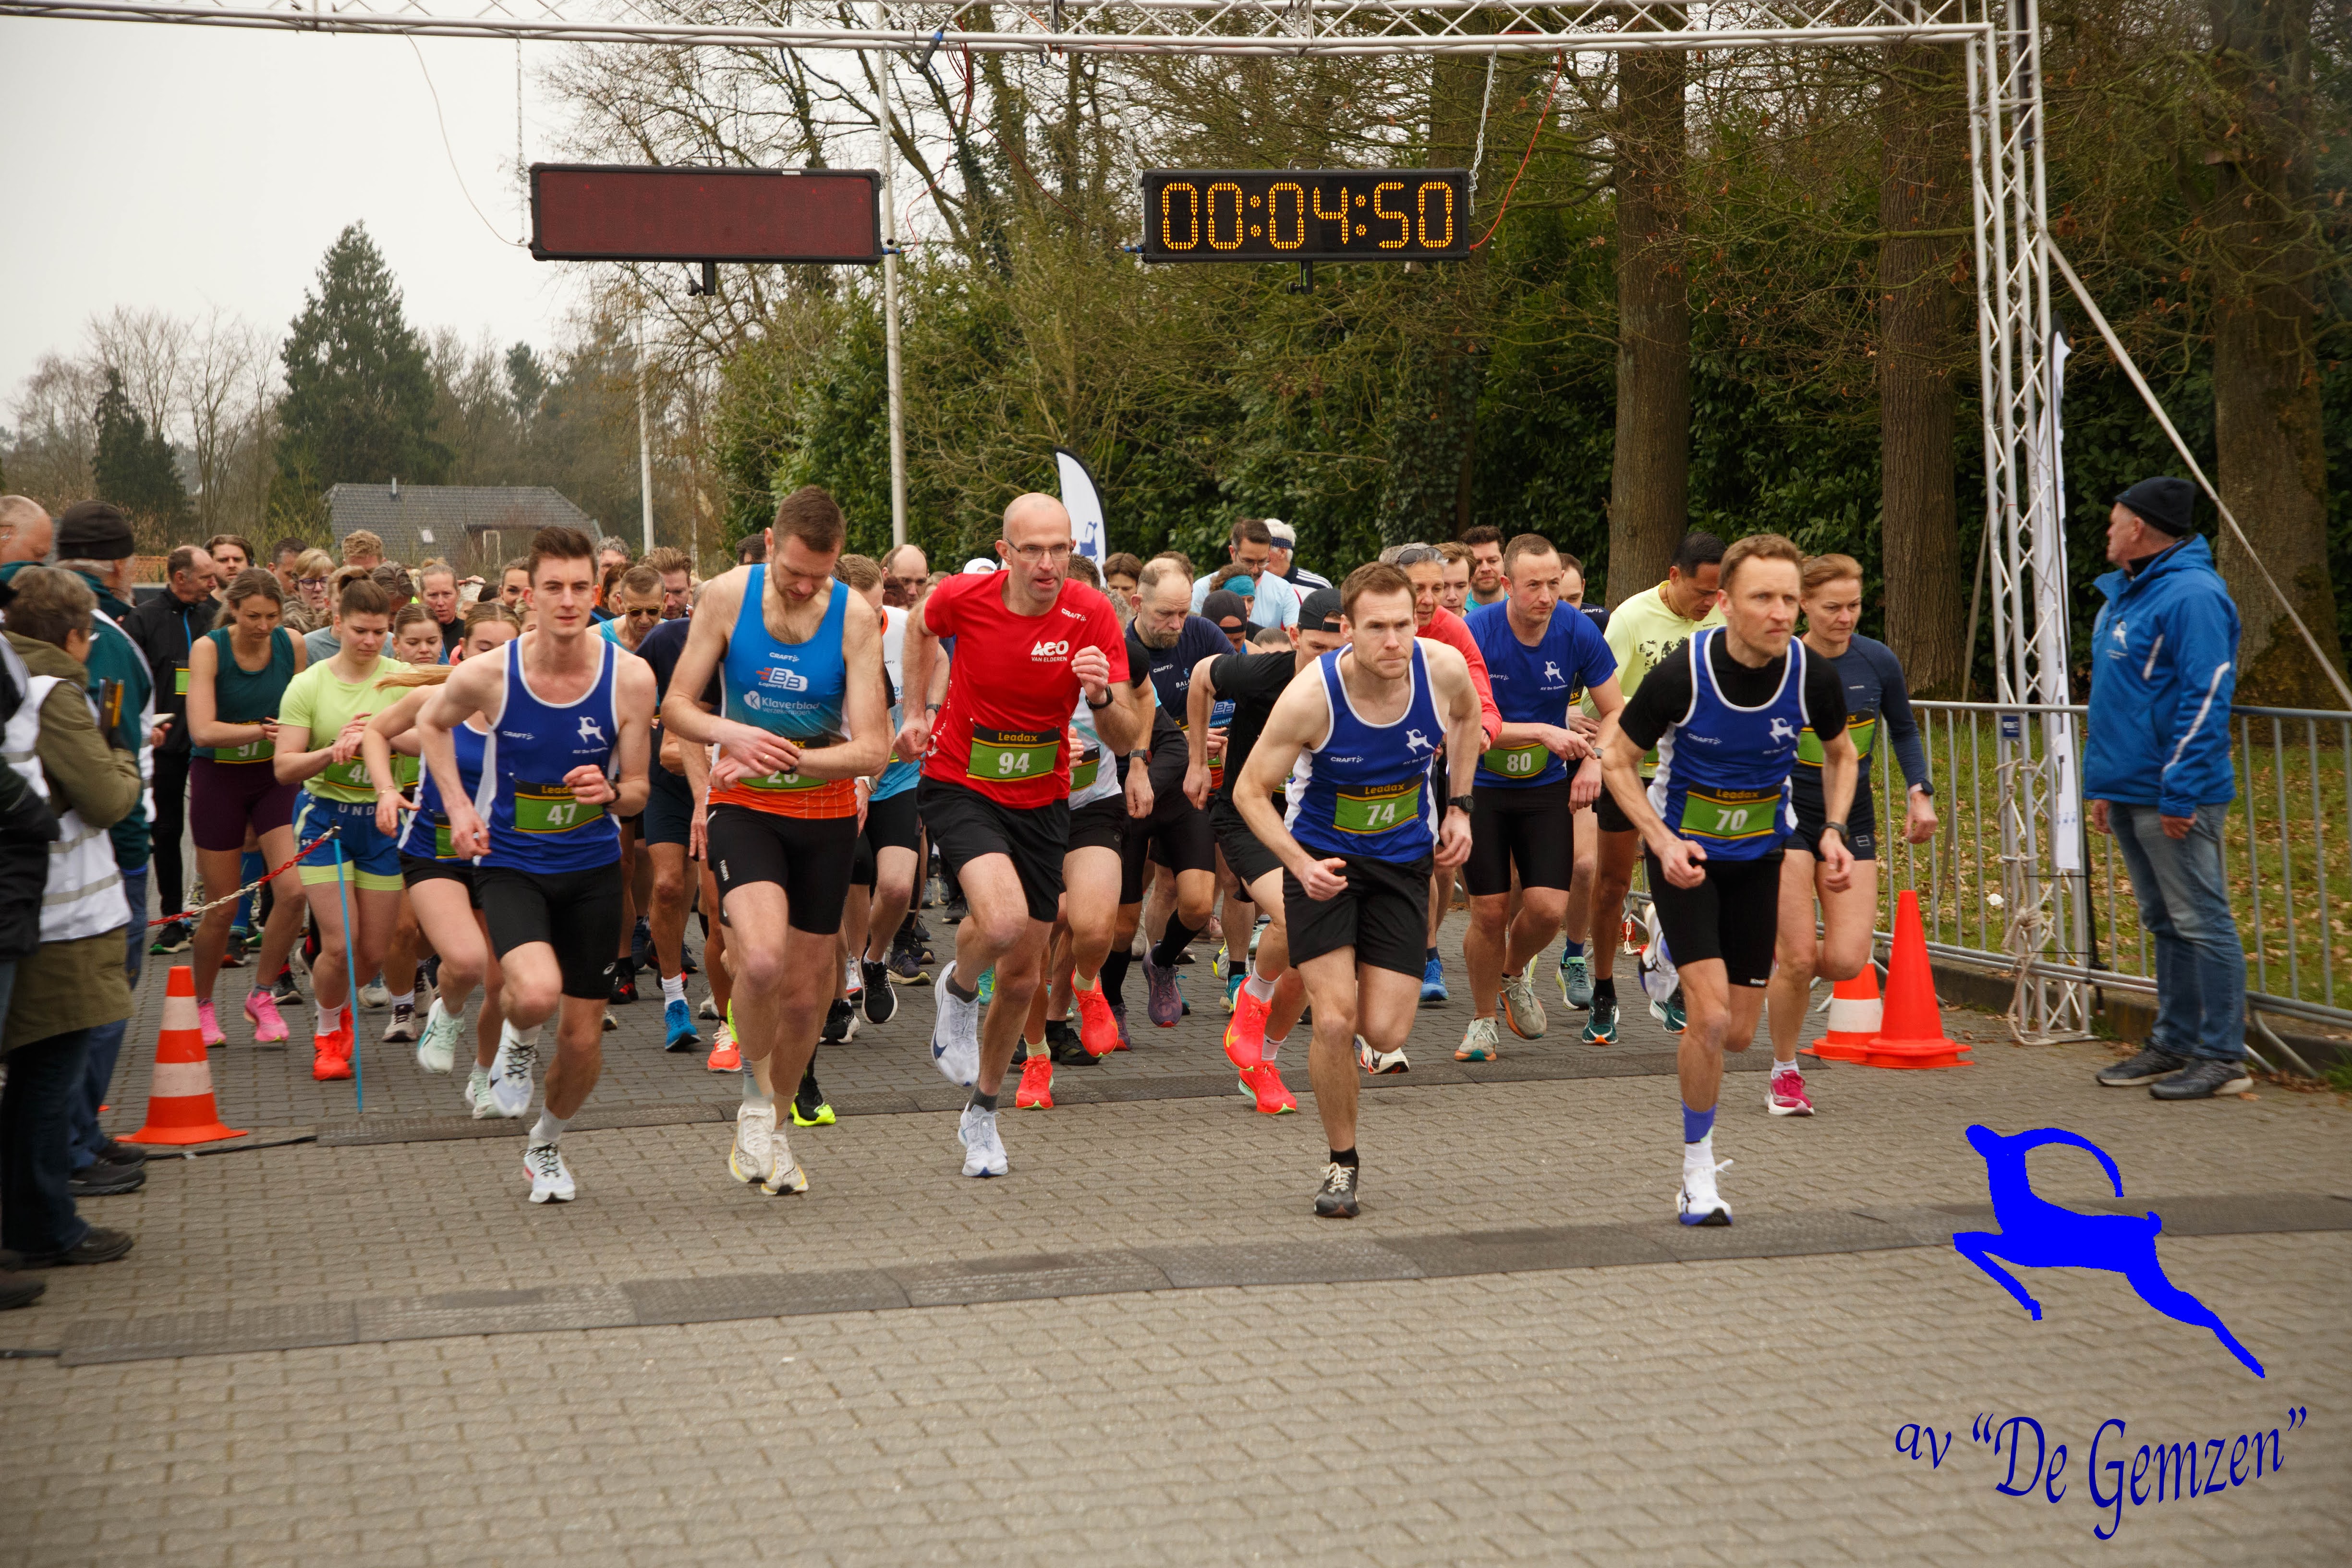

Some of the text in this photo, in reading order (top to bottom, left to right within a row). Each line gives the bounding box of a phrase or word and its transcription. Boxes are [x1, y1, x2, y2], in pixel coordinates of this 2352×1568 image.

[1162, 182, 1453, 250] 00:04:50
[1061, 608, 1082, 620] CRAFT
[769, 652, 792, 661] CRAFT
[1153, 665, 1170, 673] CRAFT
[1176, 679, 1190, 688] BALA
[762, 697, 819, 709] Klaverblad
[763, 707, 811, 716] verzekeringen
[998, 732, 1038, 742] Leadax
[1687, 733, 1714, 743] CRAFT
[998, 752, 1030, 774] 94
[1506, 752, 1532, 772] 80
[541, 785, 573, 793] Lead
[1365, 783, 1405, 795] Leadax
[1716, 788, 1758, 799] Leadax
[338, 803, 375, 815] UND
[547, 803, 577, 825] 47
[1366, 803, 1395, 826] 74
[1715, 809, 1748, 831] 70
